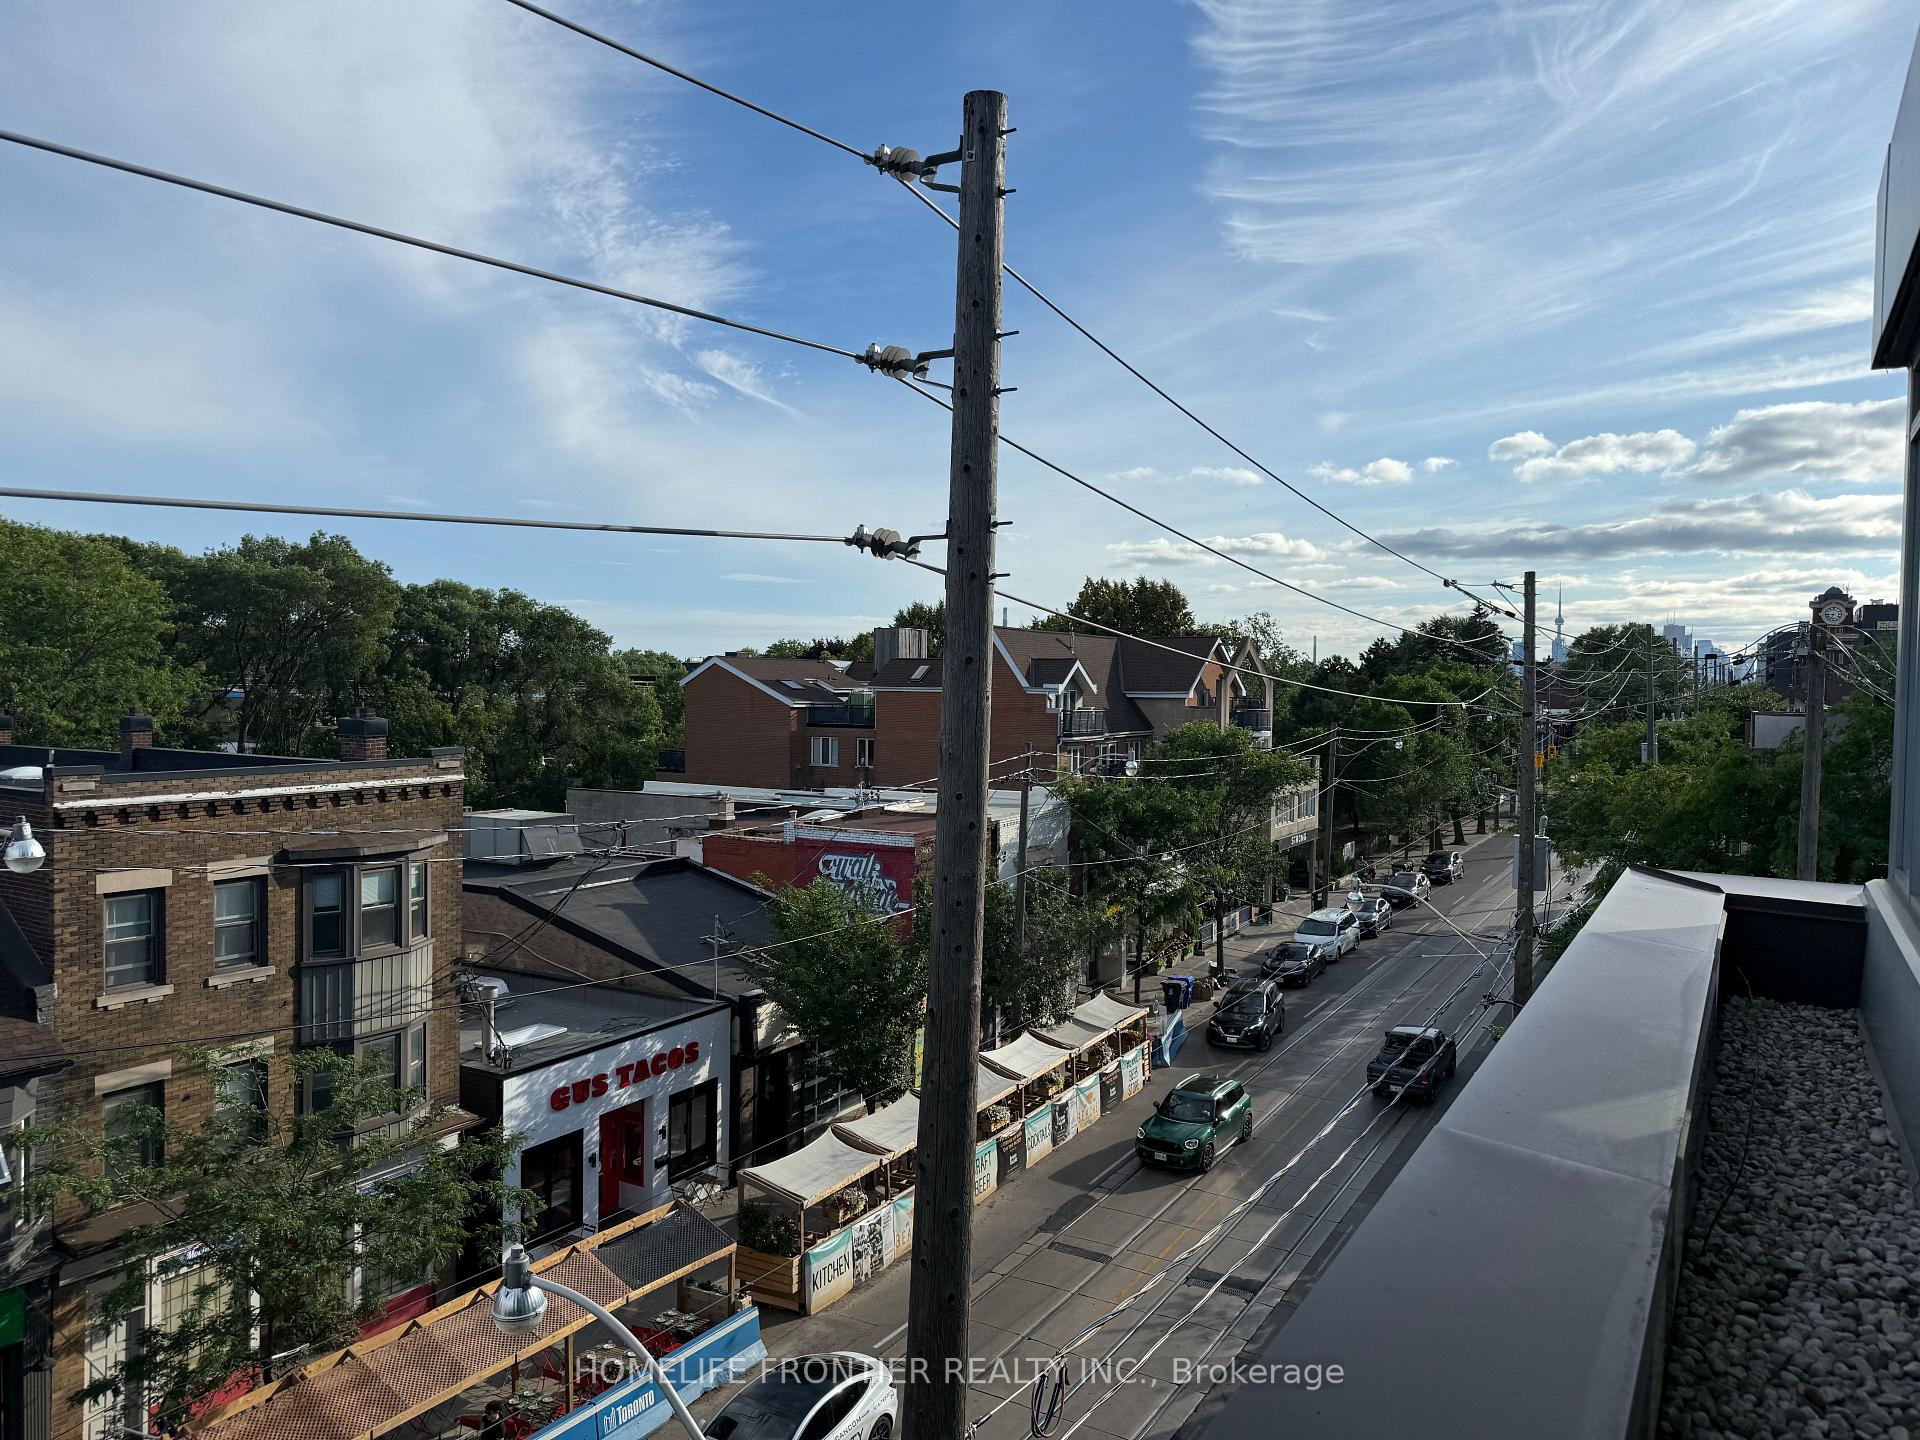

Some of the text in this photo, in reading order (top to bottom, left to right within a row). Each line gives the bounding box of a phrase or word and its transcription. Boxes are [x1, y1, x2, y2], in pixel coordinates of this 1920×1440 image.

[550, 1041, 700, 1111] GUS TACOS
[1027, 1123, 1052, 1151] COCKTAILS
[975, 1150, 992, 1176] RAFT
[974, 1173, 991, 1197] BEER
[812, 1251, 850, 1292] KITCHEN
[616, 1389, 655, 1425] TORONTO
